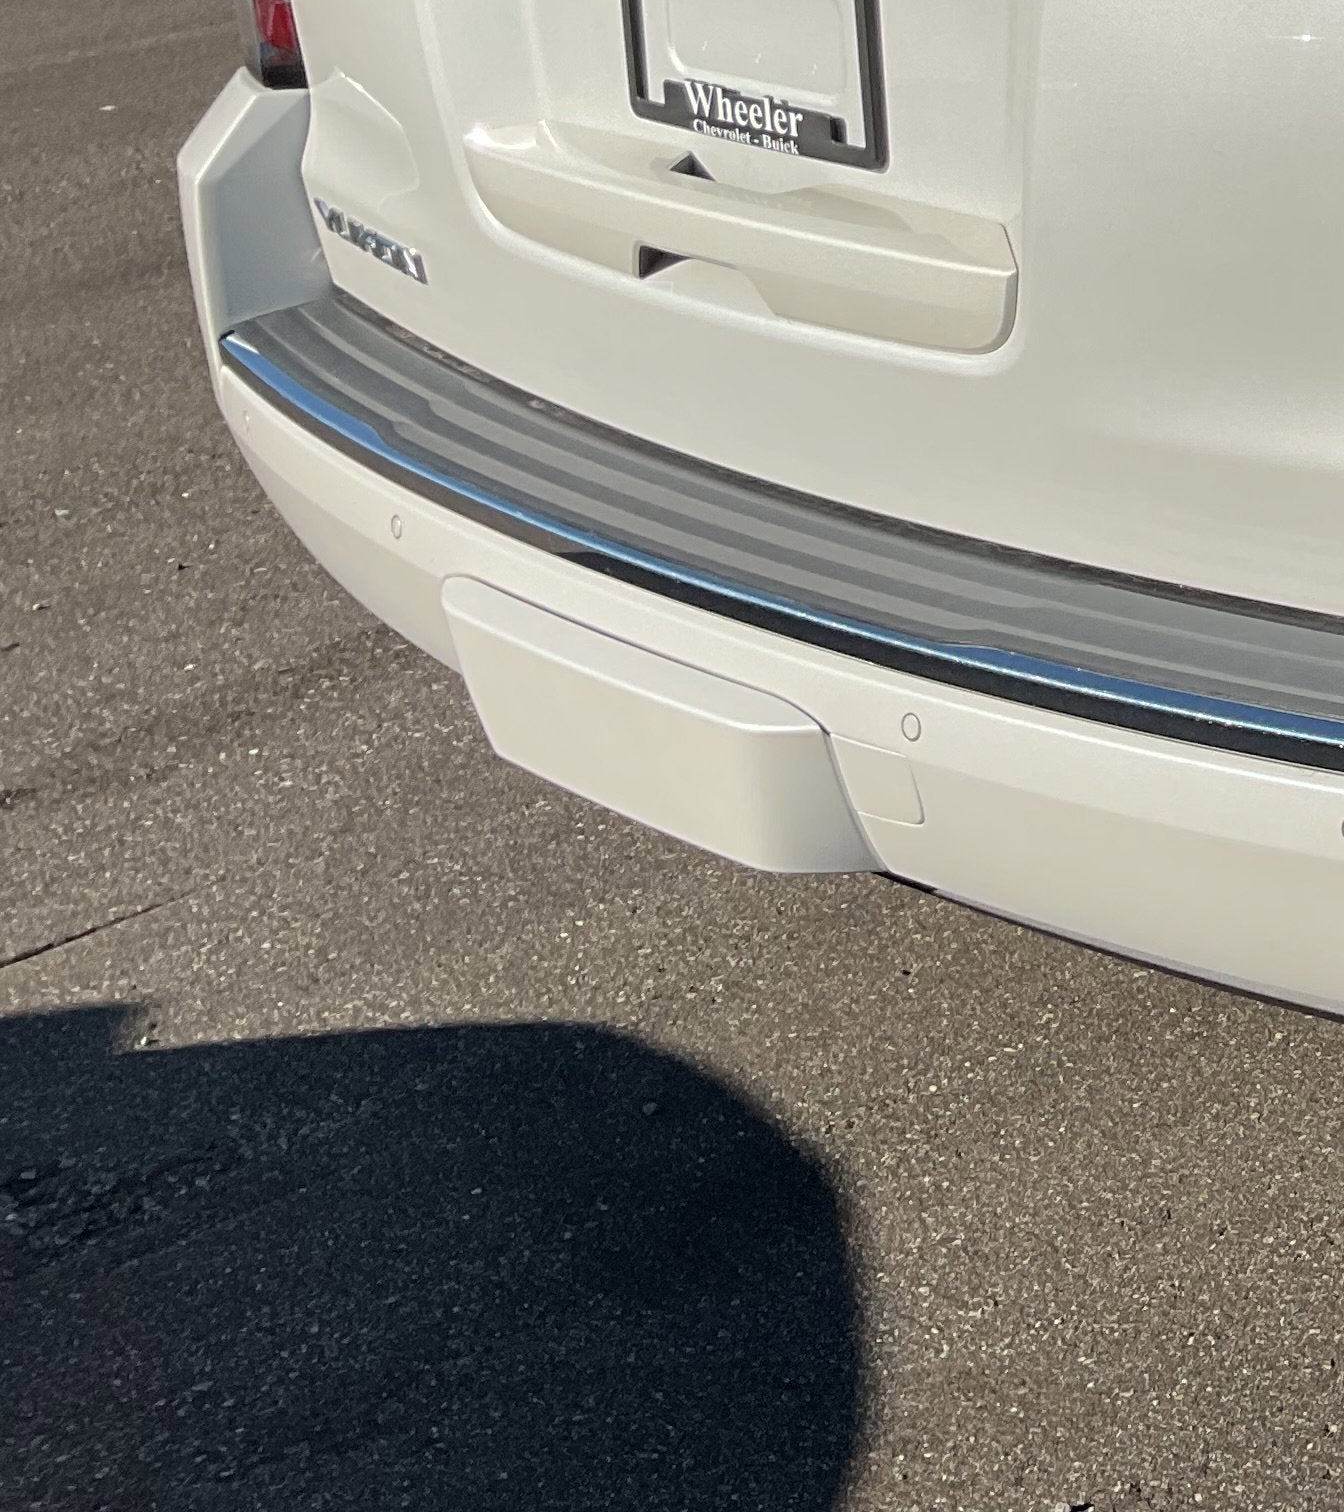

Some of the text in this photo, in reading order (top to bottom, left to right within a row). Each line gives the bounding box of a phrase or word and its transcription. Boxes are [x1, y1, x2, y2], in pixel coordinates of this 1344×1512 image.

[684, 81, 803, 138] Wheeler
[693, 118, 752, 145] Chevrolet
[762, 133, 799, 155] Buick
[314, 197, 429, 286] YUKON
